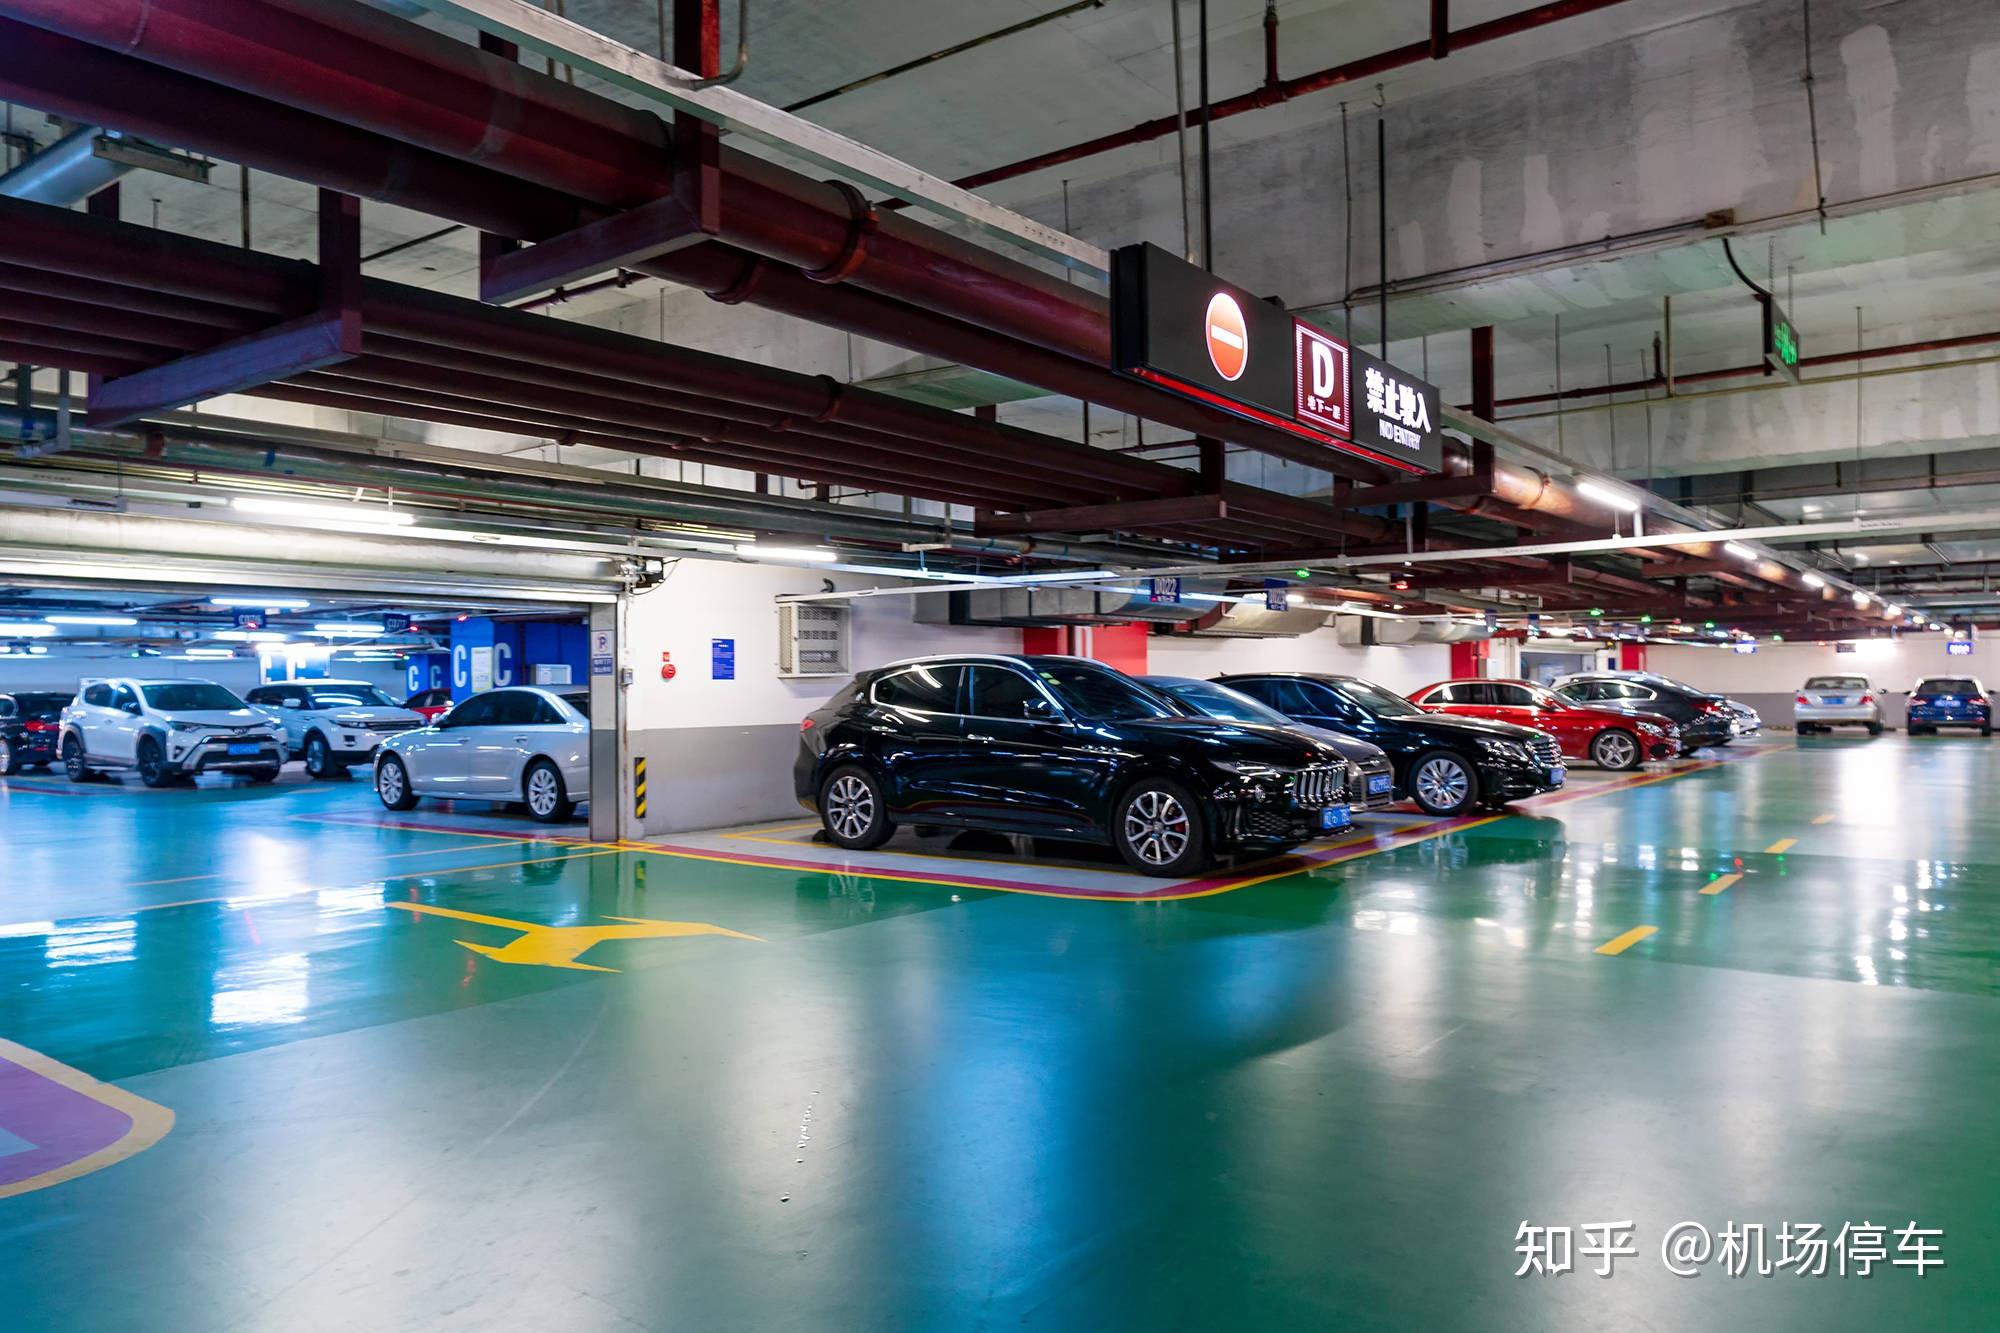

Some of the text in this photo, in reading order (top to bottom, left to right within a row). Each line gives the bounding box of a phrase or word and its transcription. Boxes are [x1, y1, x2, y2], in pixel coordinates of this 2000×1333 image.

[1312, 341, 1334, 398] D
[1379, 419, 1421, 450] NO ENTRY
[408, 665, 419, 691] C
[430, 665, 442, 689] C
[453, 644, 467, 688] C
[494, 643, 512, 686] C
